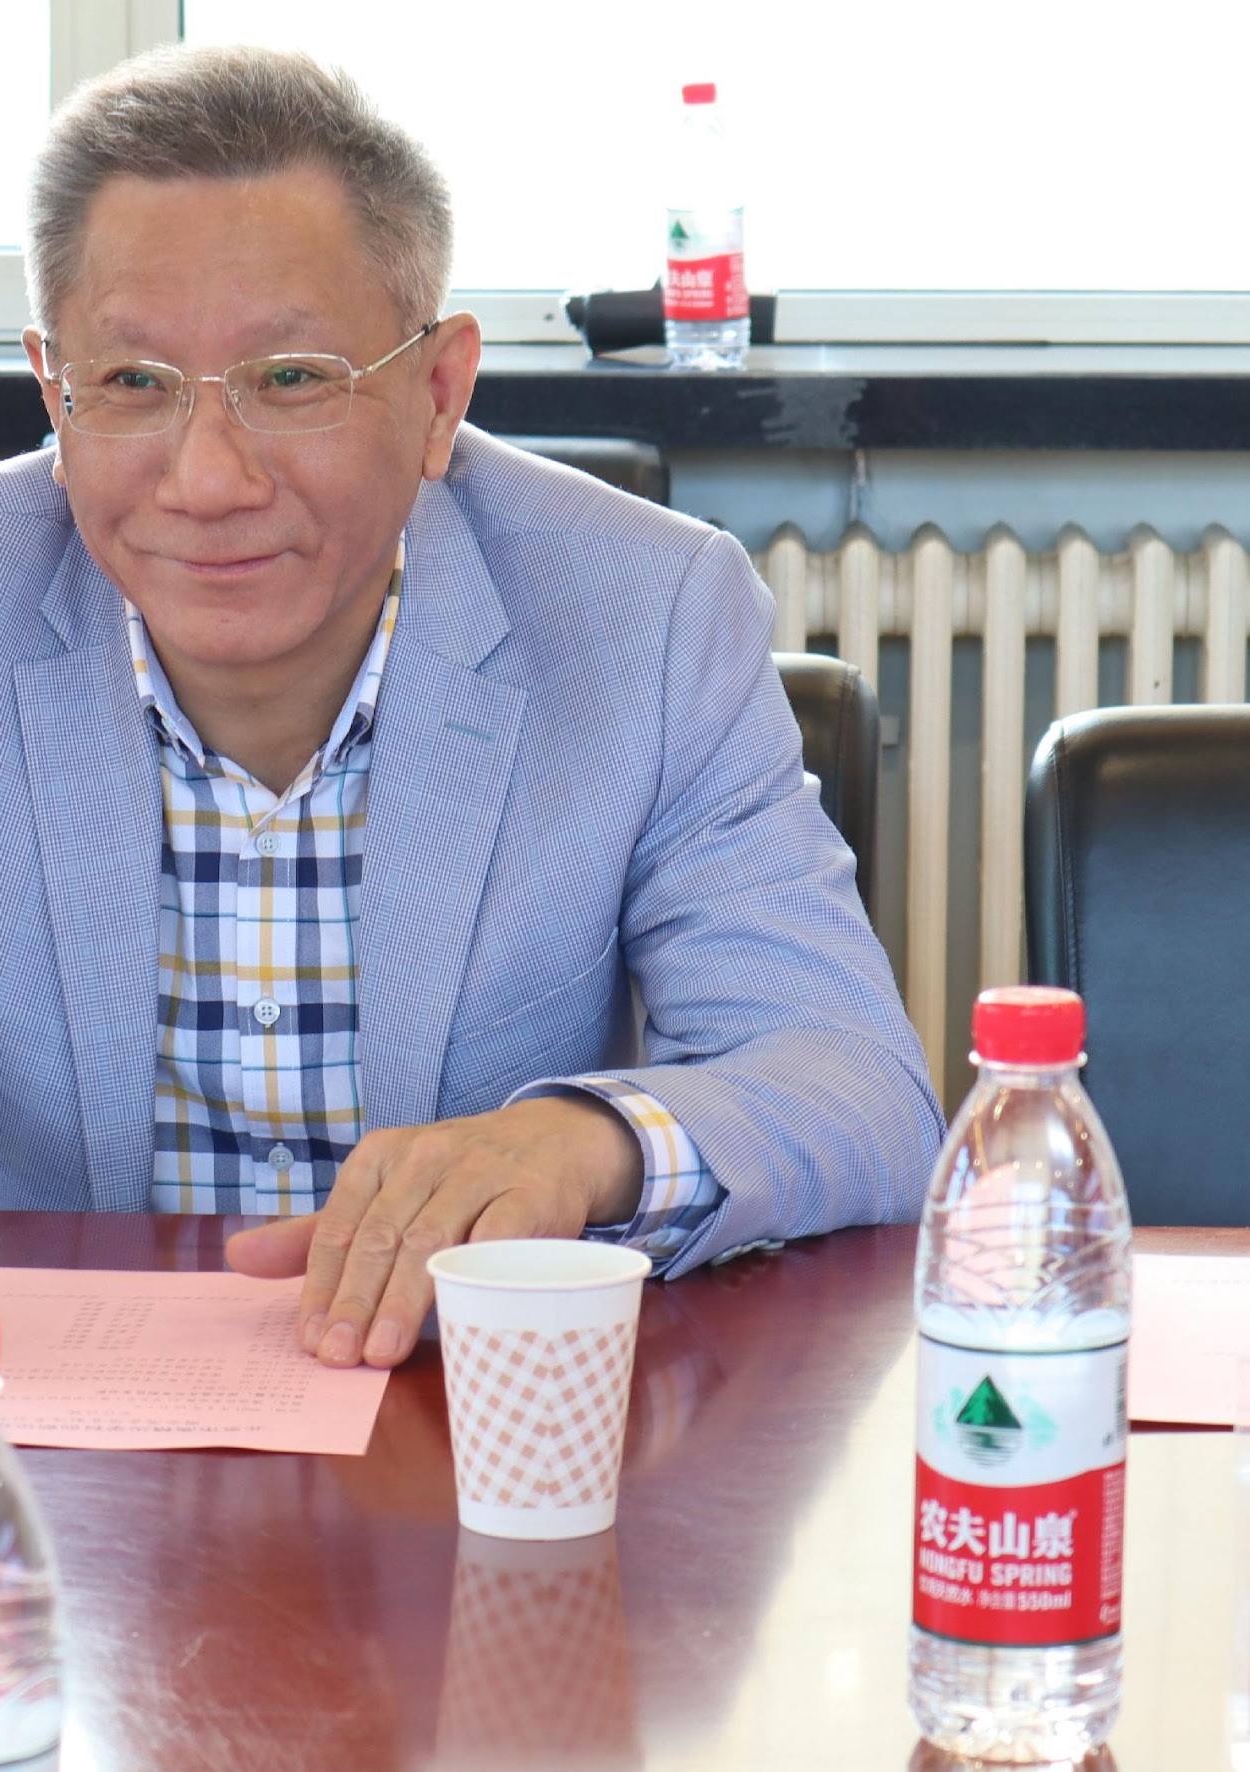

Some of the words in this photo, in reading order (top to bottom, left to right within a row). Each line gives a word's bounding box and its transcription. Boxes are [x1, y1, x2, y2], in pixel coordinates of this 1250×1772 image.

[920, 1499, 1074, 1559] 农夫山泉
[990, 1562, 1072, 1587] SPRING
